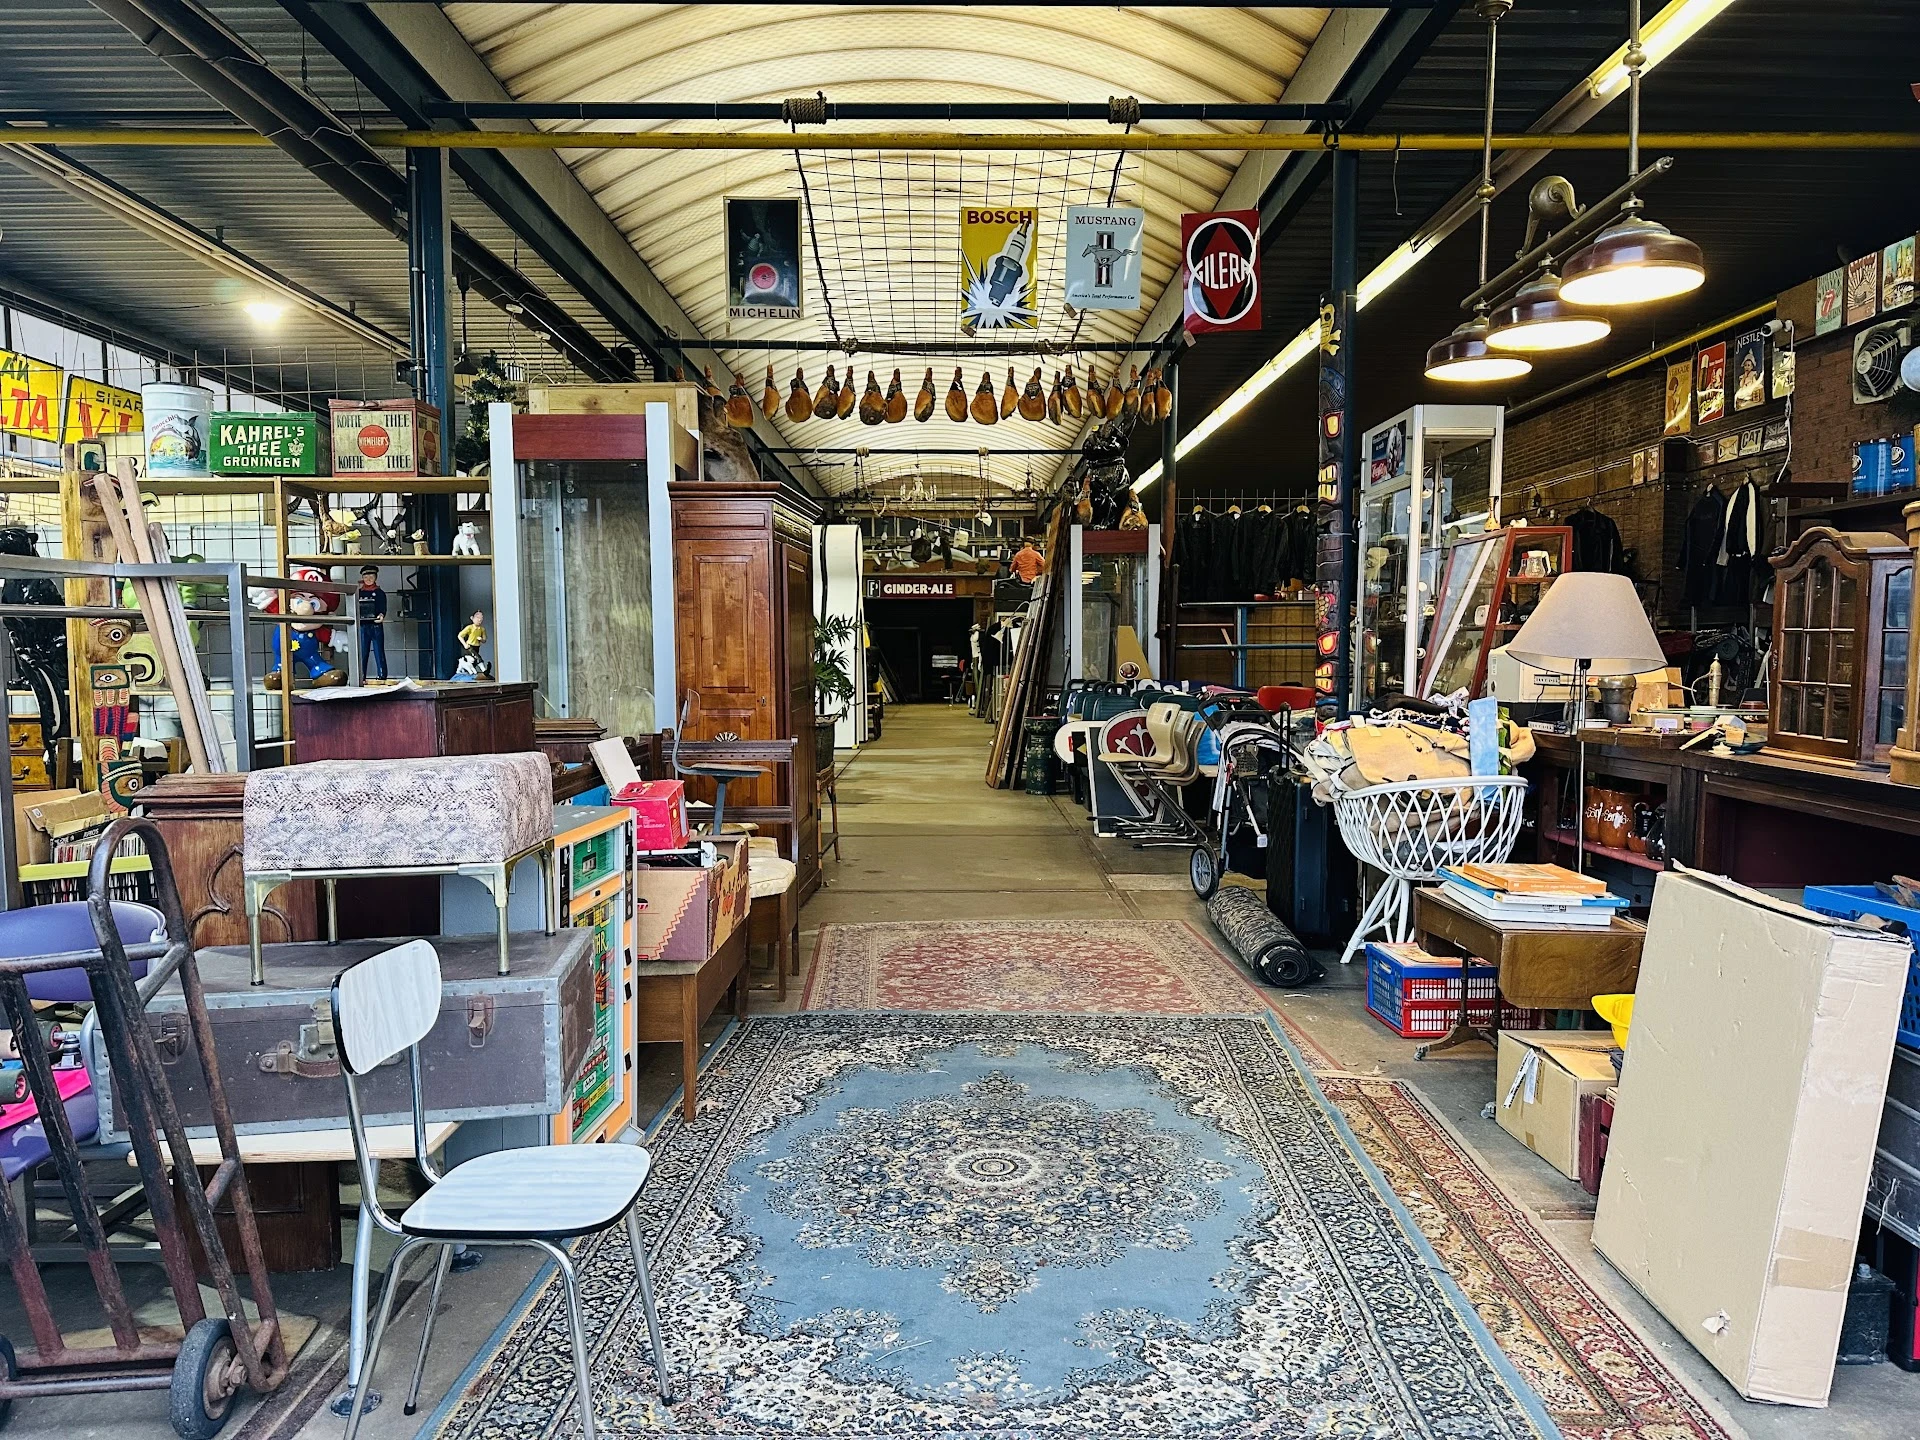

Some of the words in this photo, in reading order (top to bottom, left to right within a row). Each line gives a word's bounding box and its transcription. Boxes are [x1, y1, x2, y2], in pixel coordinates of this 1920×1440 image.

[967, 210, 1032, 225] BOSCH
[1074, 215, 1137, 227] MUSTANG
[1194, 251, 1253, 290] GILERA
[729, 307, 801, 319] MICHELIN
[151, 413, 179, 433] Pinocchio
[336, 414, 363, 429] KOFFIE
[384, 413, 410, 428] THEE
[220, 424, 305, 447] KAHREL'S
[1741, 428, 1761, 450] CAT
[237, 440, 281, 456] THEE
[223, 456, 300, 468] GRONINGEN
[338, 455, 365, 470] KOFFIE
[385, 455, 412, 470] THEE
[883, 583, 953, 595] GINDER-ALE
